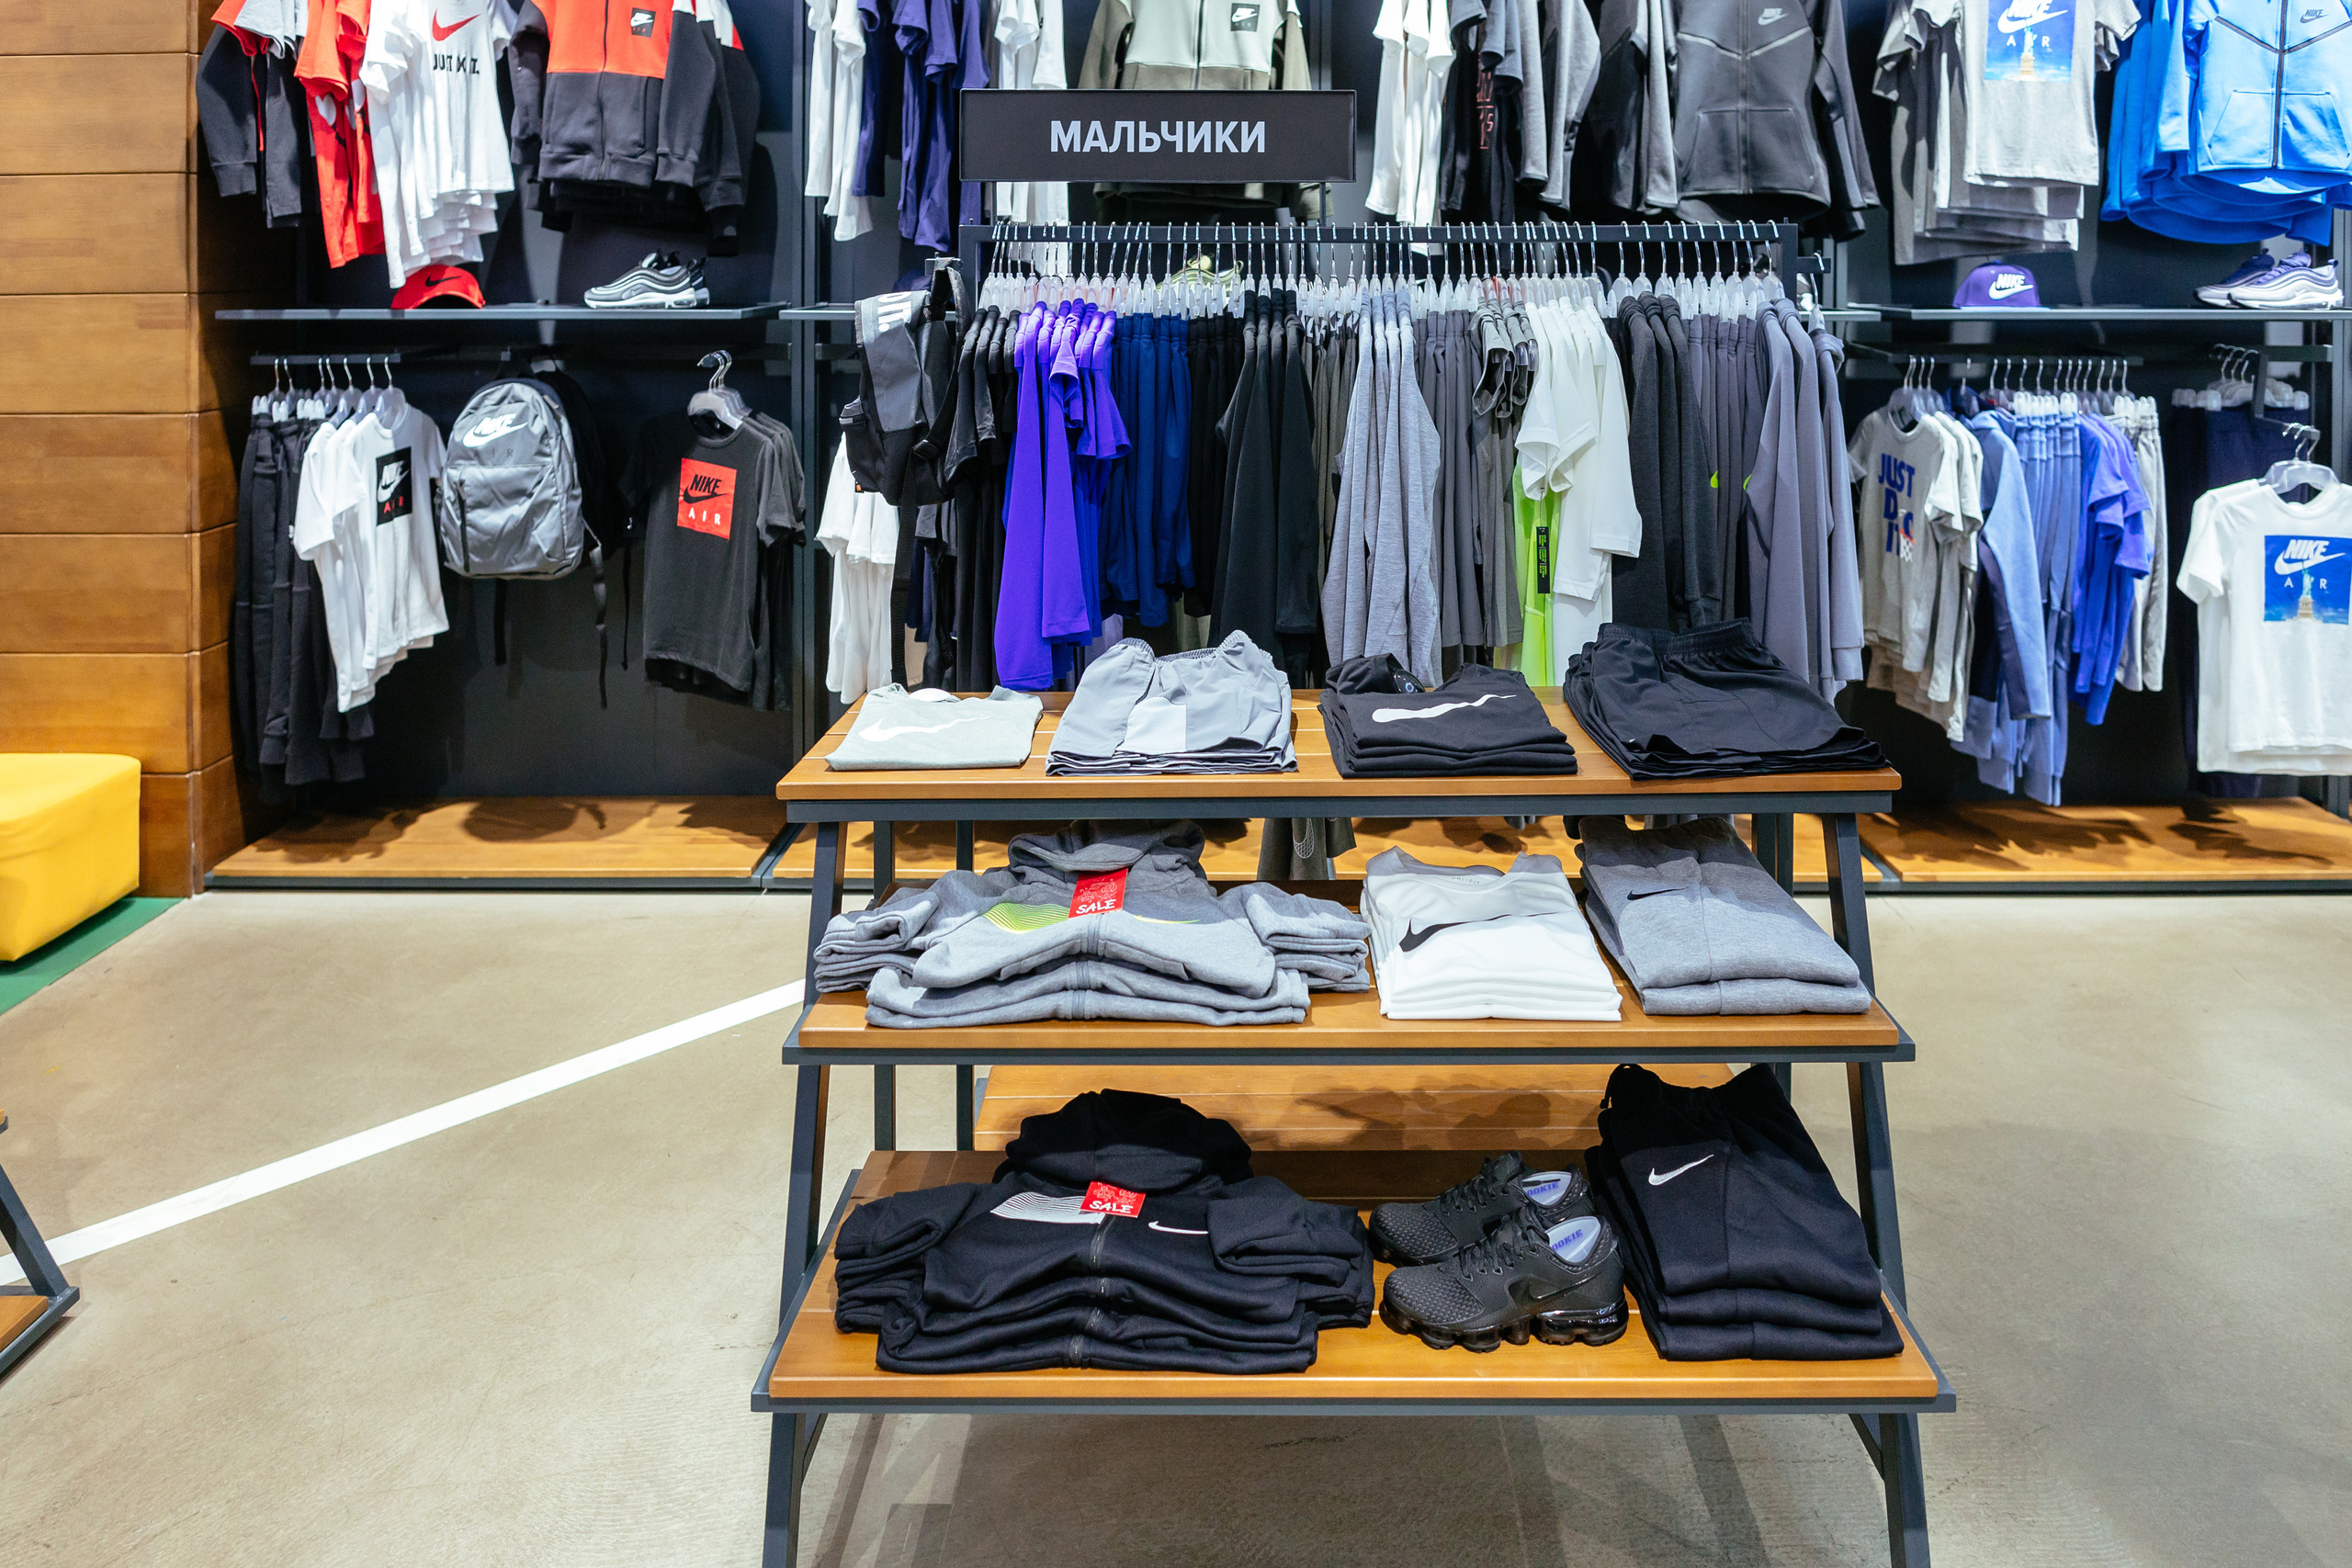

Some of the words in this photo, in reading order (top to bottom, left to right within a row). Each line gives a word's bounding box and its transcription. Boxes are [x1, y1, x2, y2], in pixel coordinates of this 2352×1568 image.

[1050, 120, 1266, 153] МАЛЬЧИКИ
[690, 474, 722, 495] NIKE
[1878, 453, 1915, 498] JUST
[384, 496, 403, 513] AIR
[688, 507, 720, 525] AIR
[2284, 539, 2329, 559] NIKE
[1076, 899, 1116, 915] SALE
[1090, 1201, 1134, 1213] SALE
